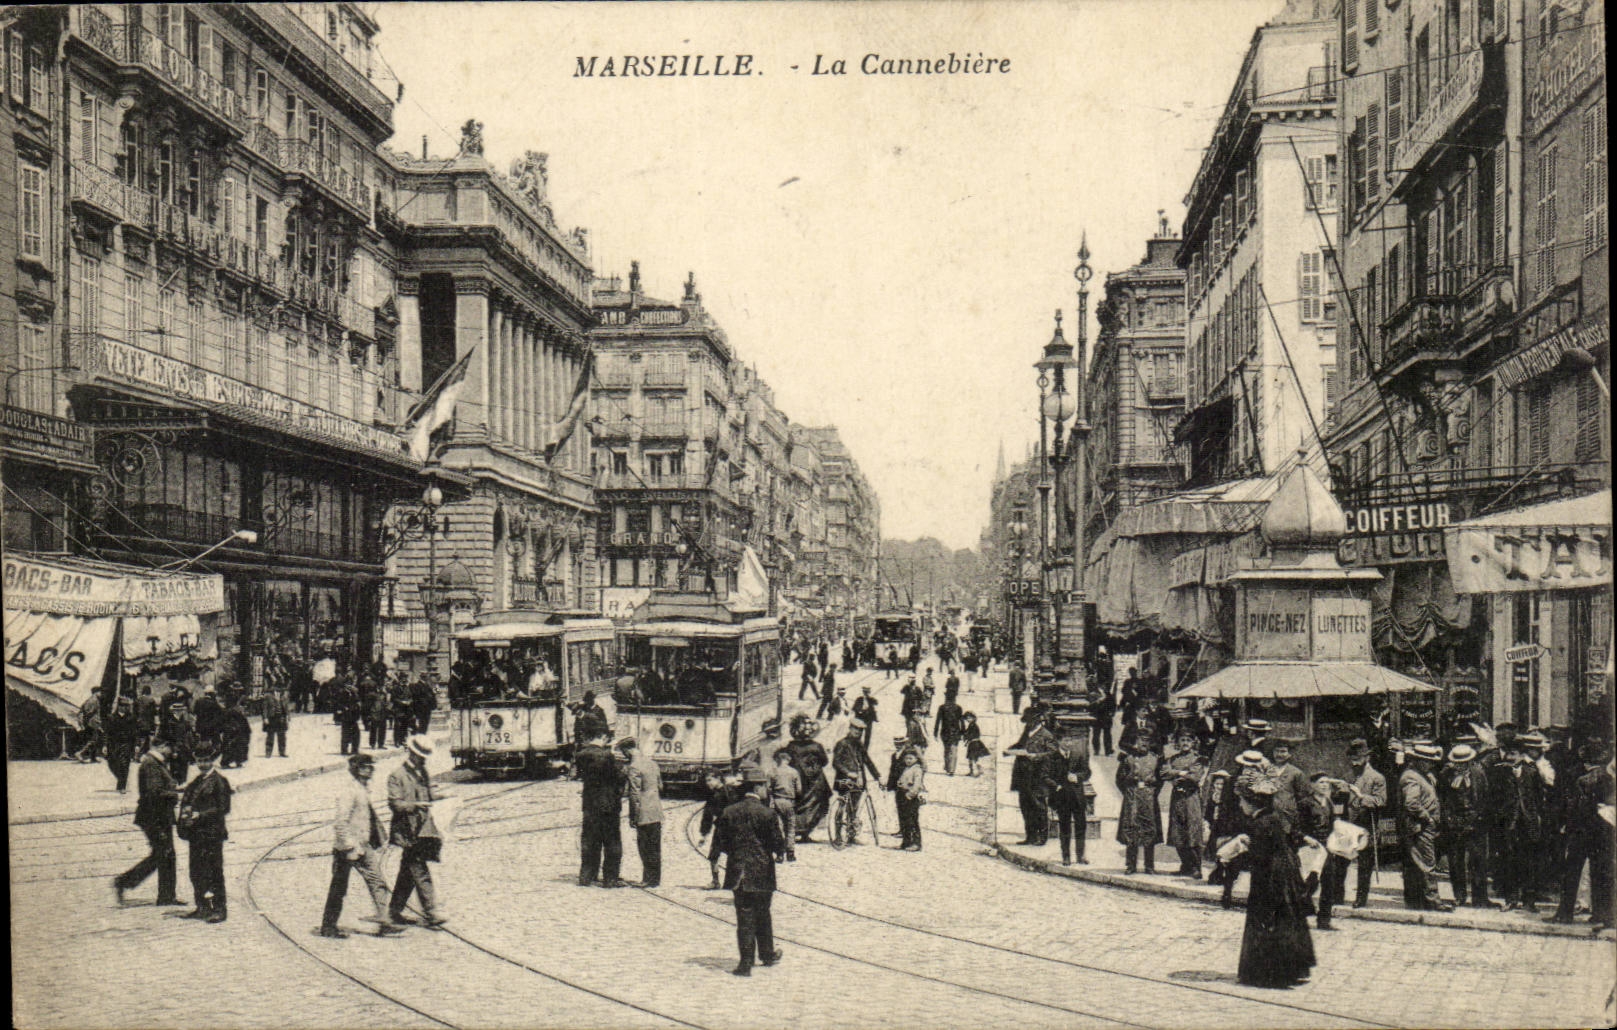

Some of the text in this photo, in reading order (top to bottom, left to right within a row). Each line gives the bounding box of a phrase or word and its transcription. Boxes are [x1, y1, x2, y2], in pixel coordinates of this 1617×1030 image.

[1546, 42, 1586, 107] HOTEL
[53, 420, 86, 441] ADAIR
[1344, 503, 1450, 533] COIFFEUR
[1250, 613, 1306, 633] PINCE-NEZ
[1318, 615, 1367, 633] LUNETTES
[485, 731, 513, 745] 732
[654, 740, 684, 755] 708
